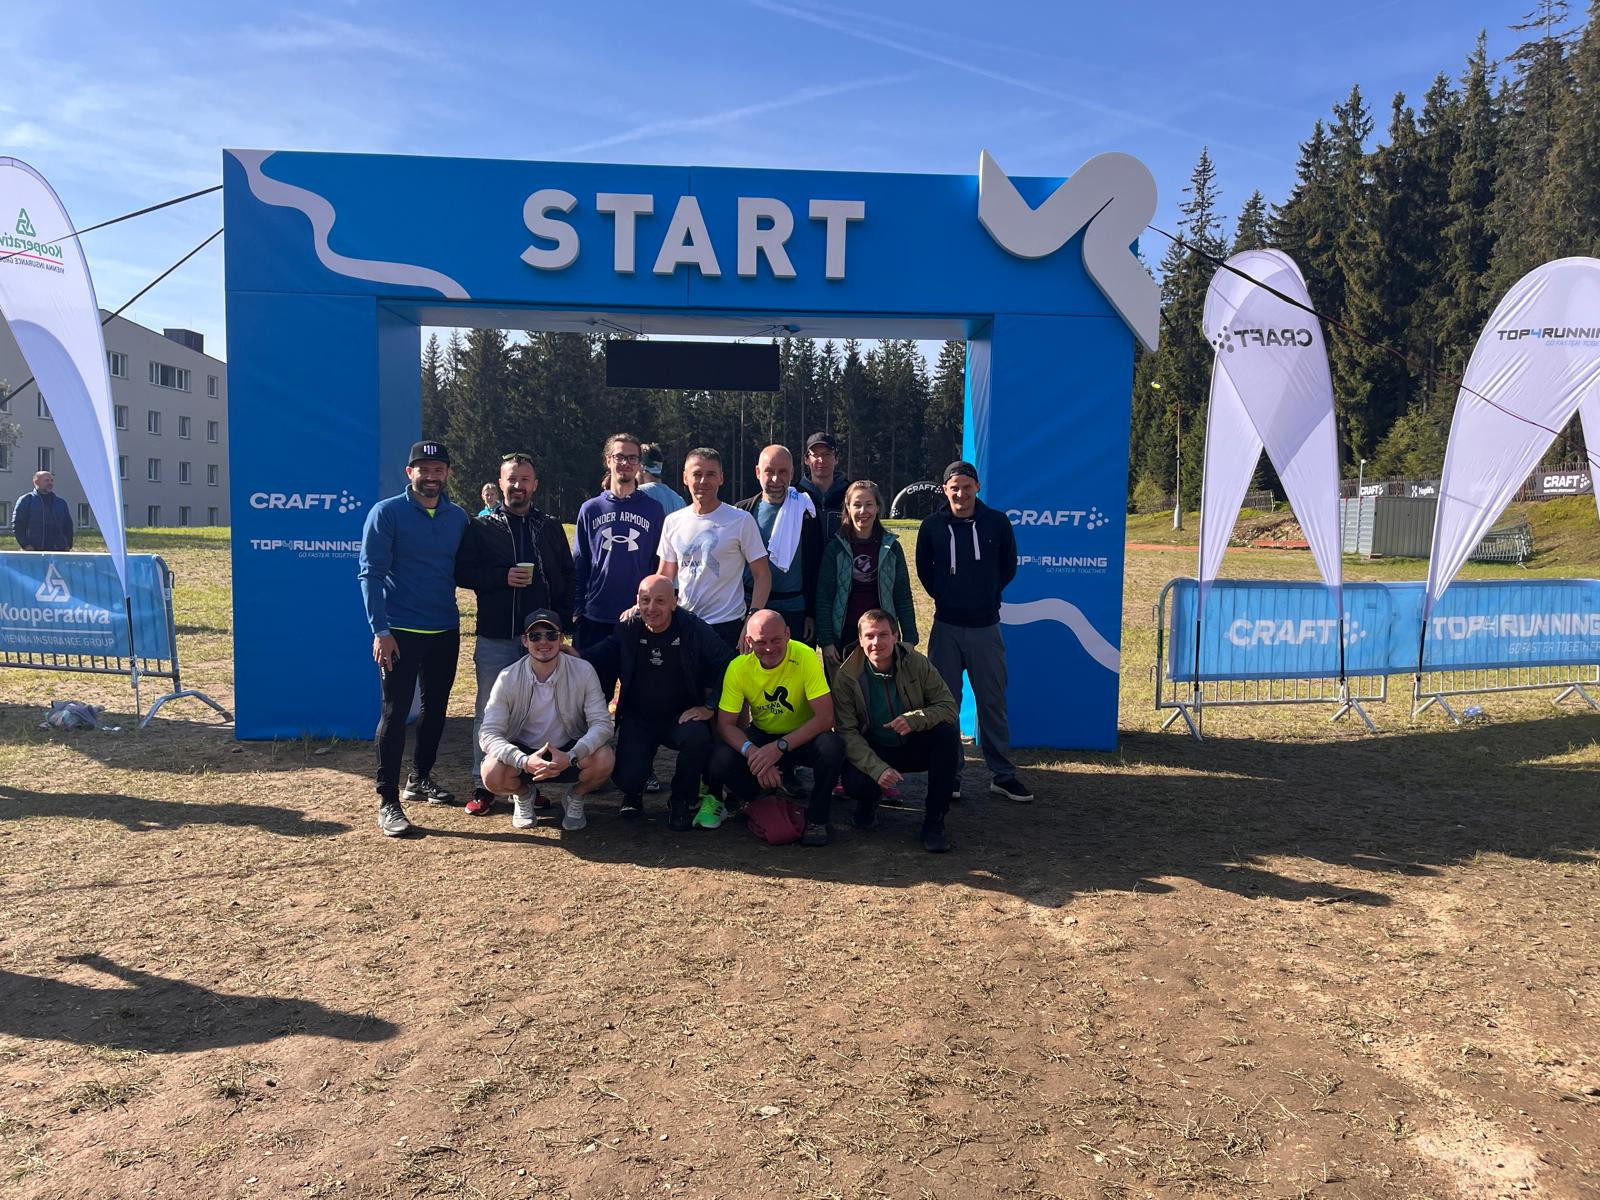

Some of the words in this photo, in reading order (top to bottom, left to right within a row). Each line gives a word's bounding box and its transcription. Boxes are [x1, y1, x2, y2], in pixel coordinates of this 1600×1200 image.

[520, 188, 866, 280] START
[1497, 327, 1600, 341] TOP4RUNNI
[1543, 475, 1580, 488] CRAFT
[906, 484, 937, 495] CRAFT
[1360, 485, 1379, 496] CRAFT
[249, 492, 338, 510] CRAFT
[592, 511, 617, 530] UNDER
[619, 511, 650, 532] ARMOUR
[1005, 509, 1087, 526] CRAFT
[250, 539, 362, 551] TOP4RUNNING
[1016, 555, 1108, 567] P4RUNNING
[0, 602, 111, 627] Kooperativa
[1229, 618, 1337, 646] CRAFT
[2, 633, 33, 645] VIENNA
[33, 634, 81, 647] INSURANCE
[83, 637, 115, 648] GROUP
